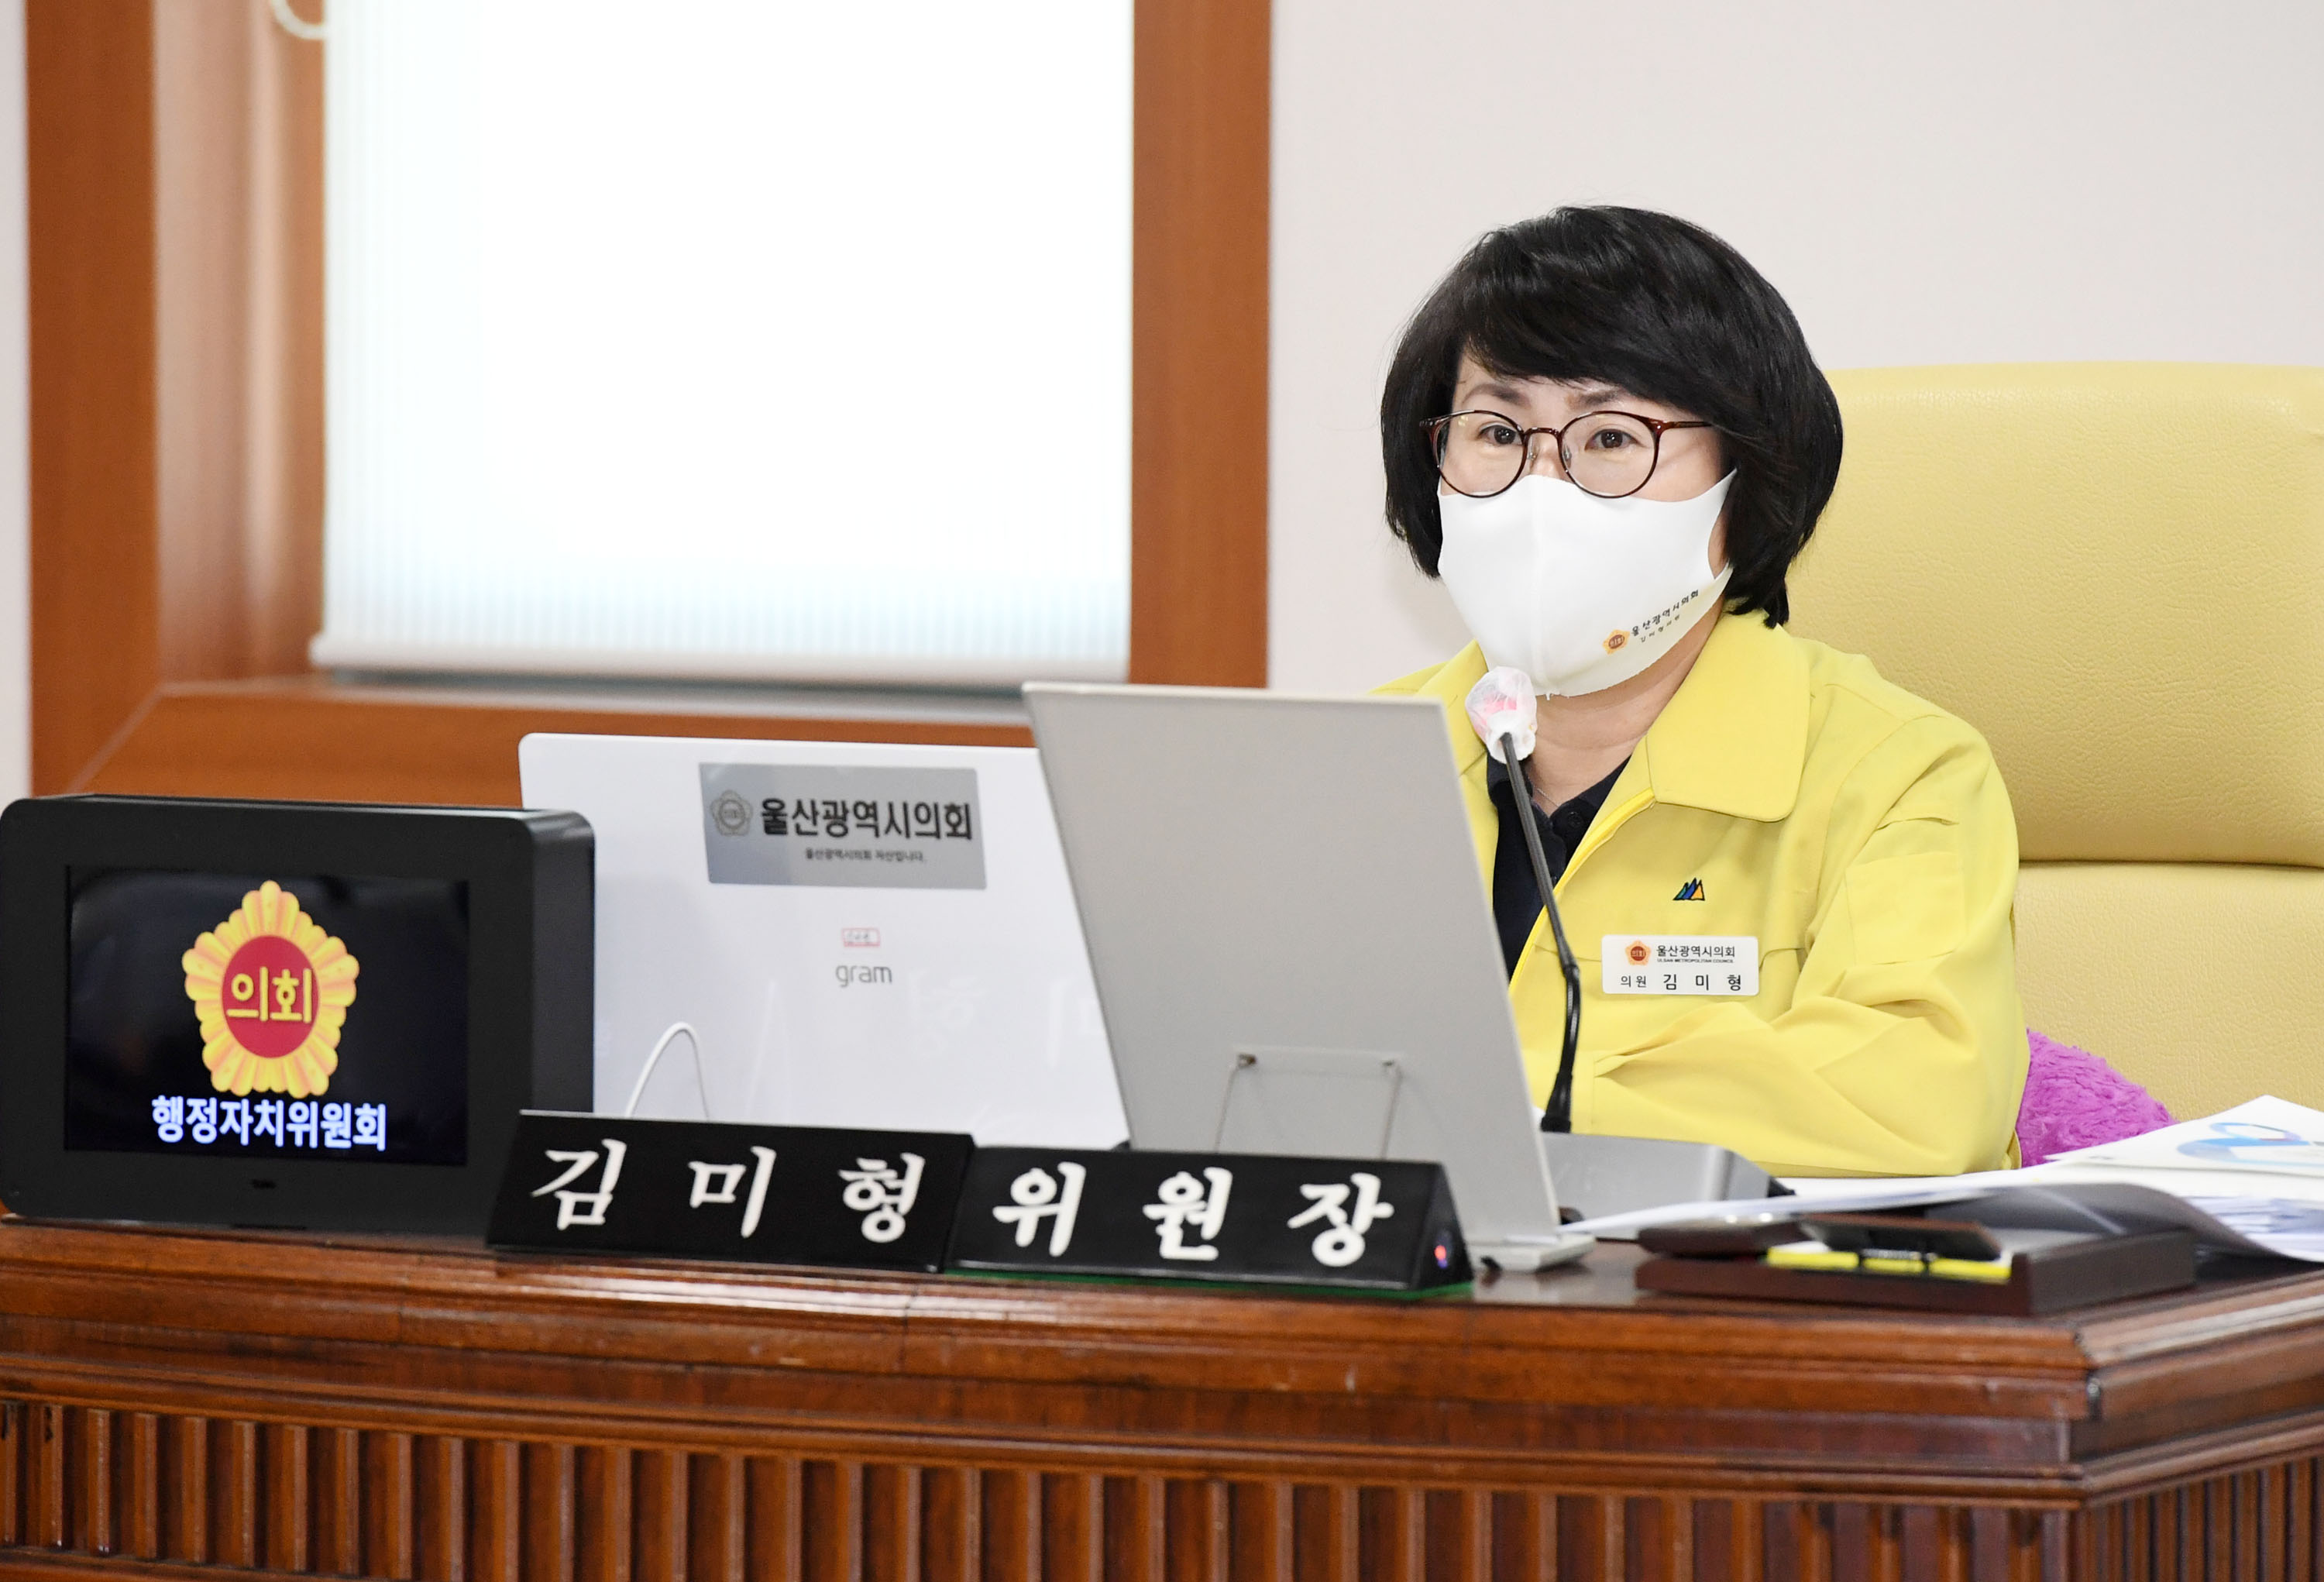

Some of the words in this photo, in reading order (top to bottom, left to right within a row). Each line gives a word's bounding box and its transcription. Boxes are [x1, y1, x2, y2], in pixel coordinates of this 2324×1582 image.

[1631, 590, 1699, 636] 울산광역시의회
[761, 797, 973, 841] 울산광역시의회
[1655, 944, 1735, 958] 울산광역시의회
[226, 966, 312, 1023] 의회
[835, 965, 892, 988] gram
[152, 1094, 387, 1151] 행정자치위원회
